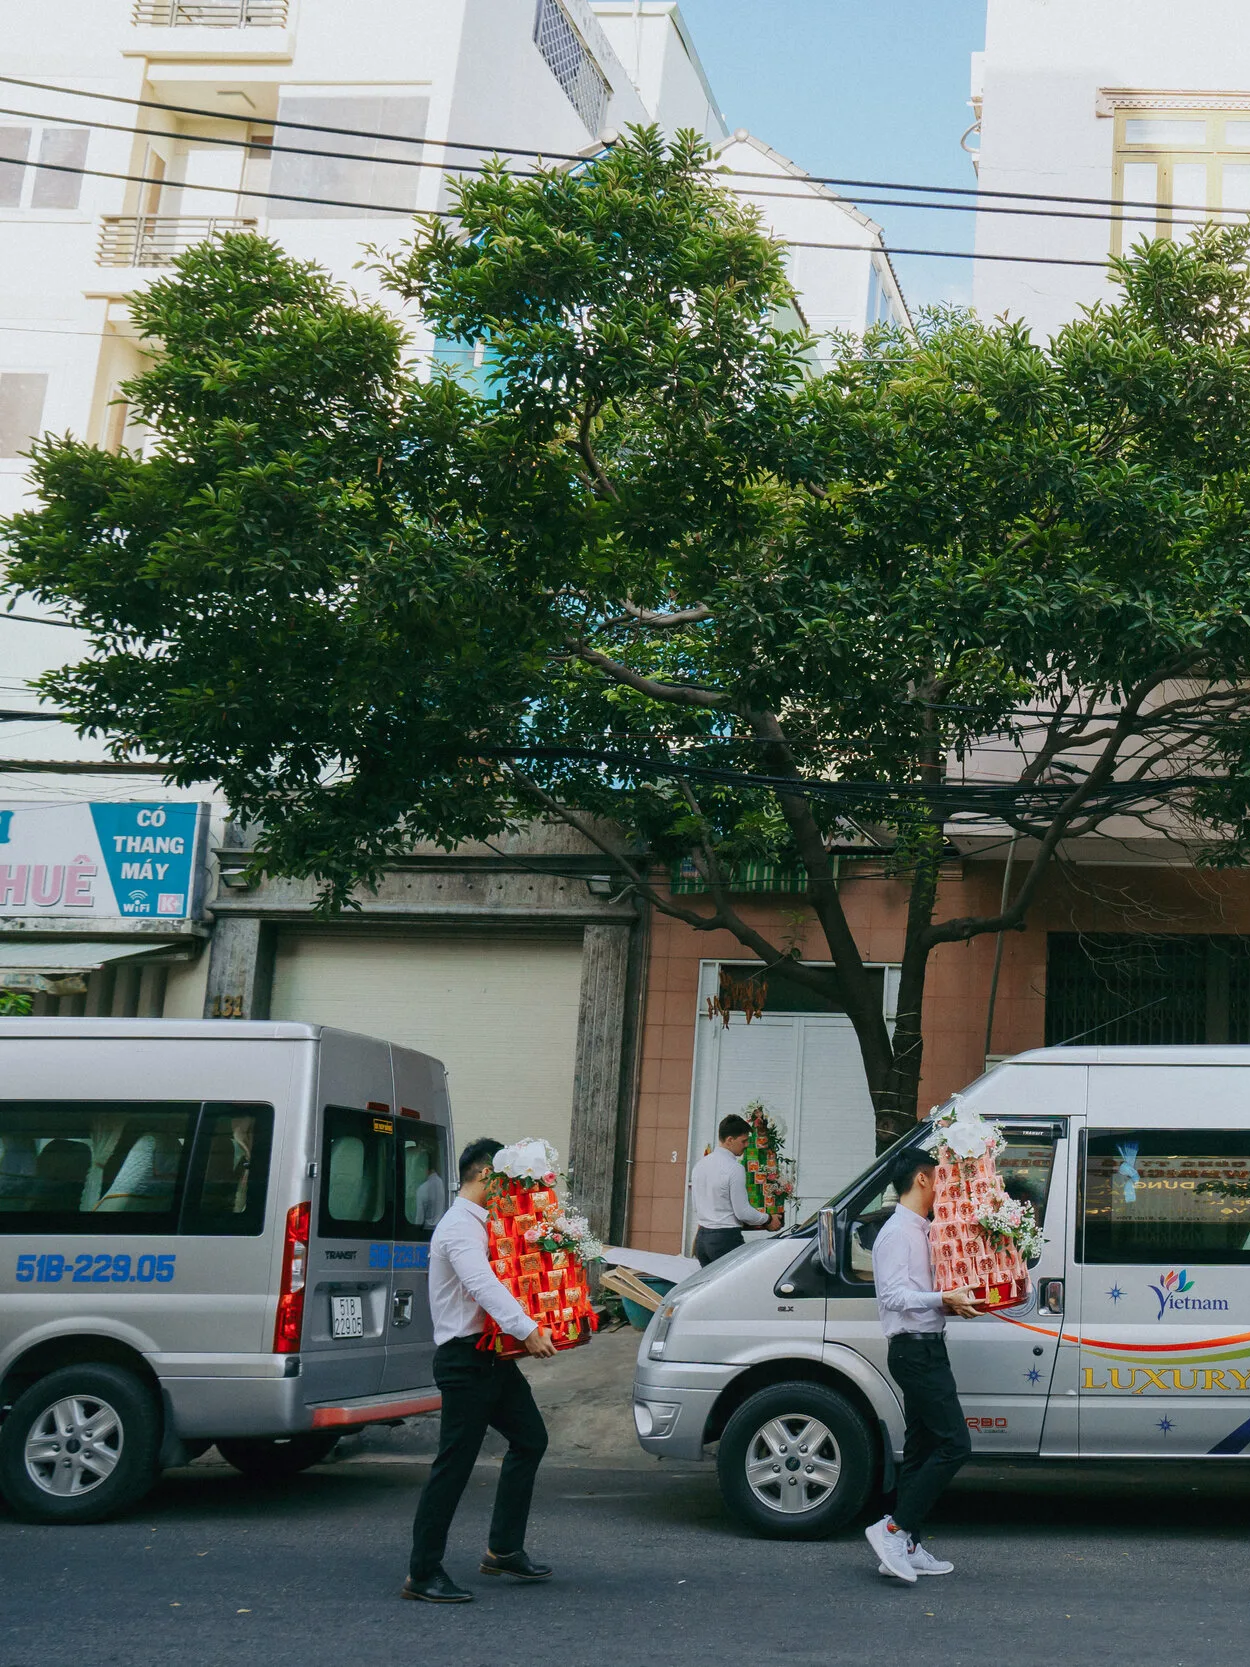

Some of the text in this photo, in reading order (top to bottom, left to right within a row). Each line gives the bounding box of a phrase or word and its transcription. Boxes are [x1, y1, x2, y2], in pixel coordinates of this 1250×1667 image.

[136, 805, 167, 828] CÓ
[112, 835, 185, 854] THANG
[120, 858, 170, 880] MÁY
[212, 995, 243, 1017] 131
[324, 1250, 358, 1260] TRANSIT
[16, 1254, 177, 1283] 51B-229.05
[340, 1298, 355, 1315] 51B
[1147, 1284, 1229, 1321] Vietnam
